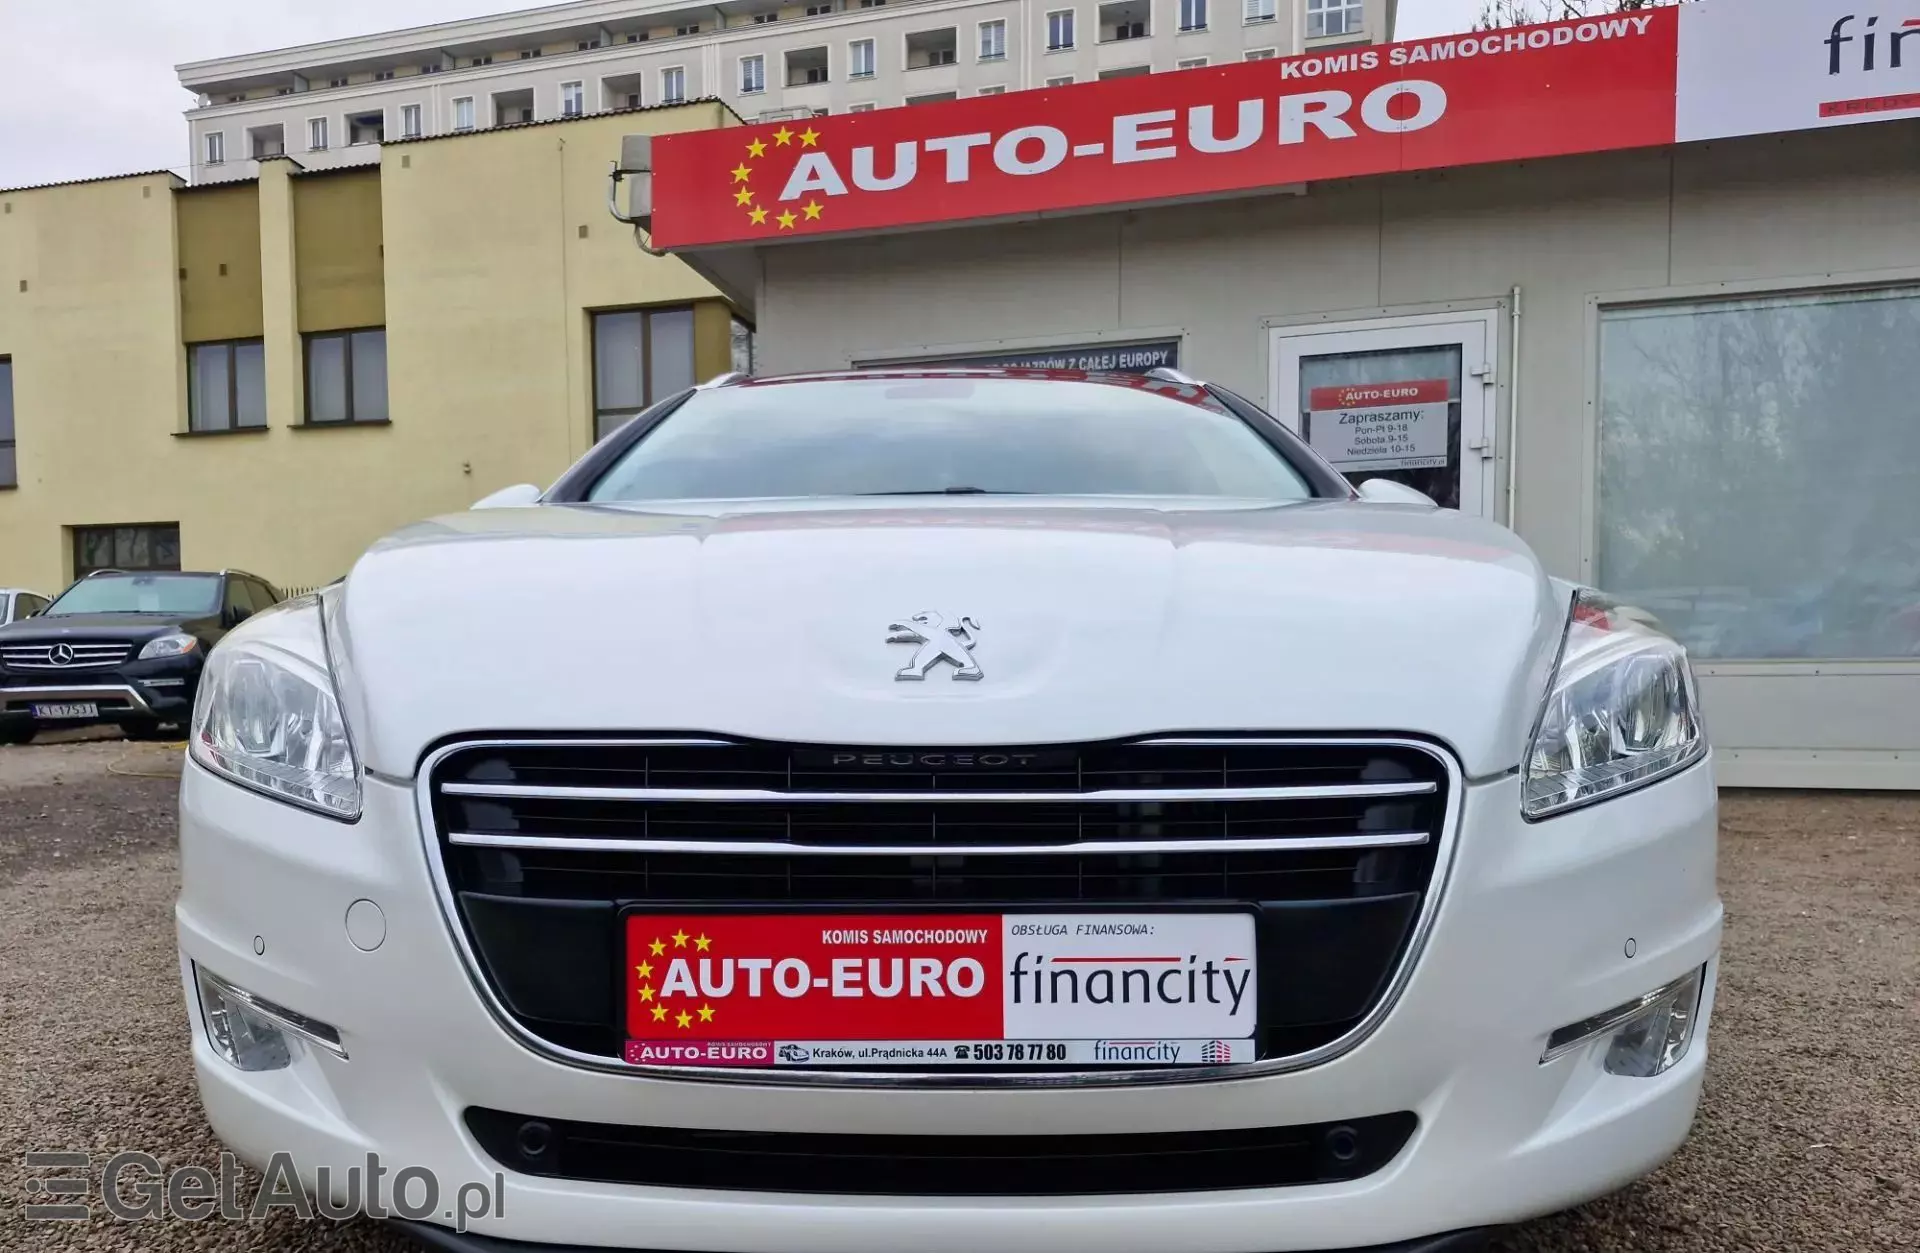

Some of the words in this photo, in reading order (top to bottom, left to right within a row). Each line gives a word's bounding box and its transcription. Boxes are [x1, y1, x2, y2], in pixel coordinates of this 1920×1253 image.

[1280, 51, 1379, 80] KOMIS
[1389, 15, 1654, 67] SAMOCHODOWY
[778, 79, 1448, 201] AUTO-EURO
[1079, 354, 1117, 371] CAŁEJ
[1119, 350, 1168, 369] EUROPY
[1345, 387, 1418, 401] AUTO-EURO
[1339, 409, 1425, 425] Zapraszamy:
[1355, 425, 1385, 435] Pon-Pt
[1388, 424, 1408, 433] 9-18
[1355, 435, 1386, 446] Sobota
[1388, 434, 1408, 443] 9-15
[1347, 446, 1388, 456] Niedziela
[1391, 444, 1415, 454] 10-15
[833, 753, 1038, 766] PEUGEOT
[822, 929, 869, 944] KOMIS
[872, 929, 988, 944] SAMOCHODOWY
[1011, 924, 1068, 937] OBSŁUGA
[1076, 924, 1155, 937] FINANSOWA:
[659, 957, 985, 998] AUTO-EURO
[1010, 951, 1251, 1016] financity
[640, 1046, 768, 1060] AUTO-EURO
[812, 1047, 856, 1060] Kraków,
[858, 1047, 925, 1061] ul.Prądnicka
[927, 1047, 948, 1058] 44A
[973, 1043, 1003, 1061] 503
[1007, 1043, 1025, 1060] 78
[1027, 1043, 1044, 1060] 77
[1046, 1043, 1067, 1060] 80
[1094, 1039, 1181, 1064] financity
